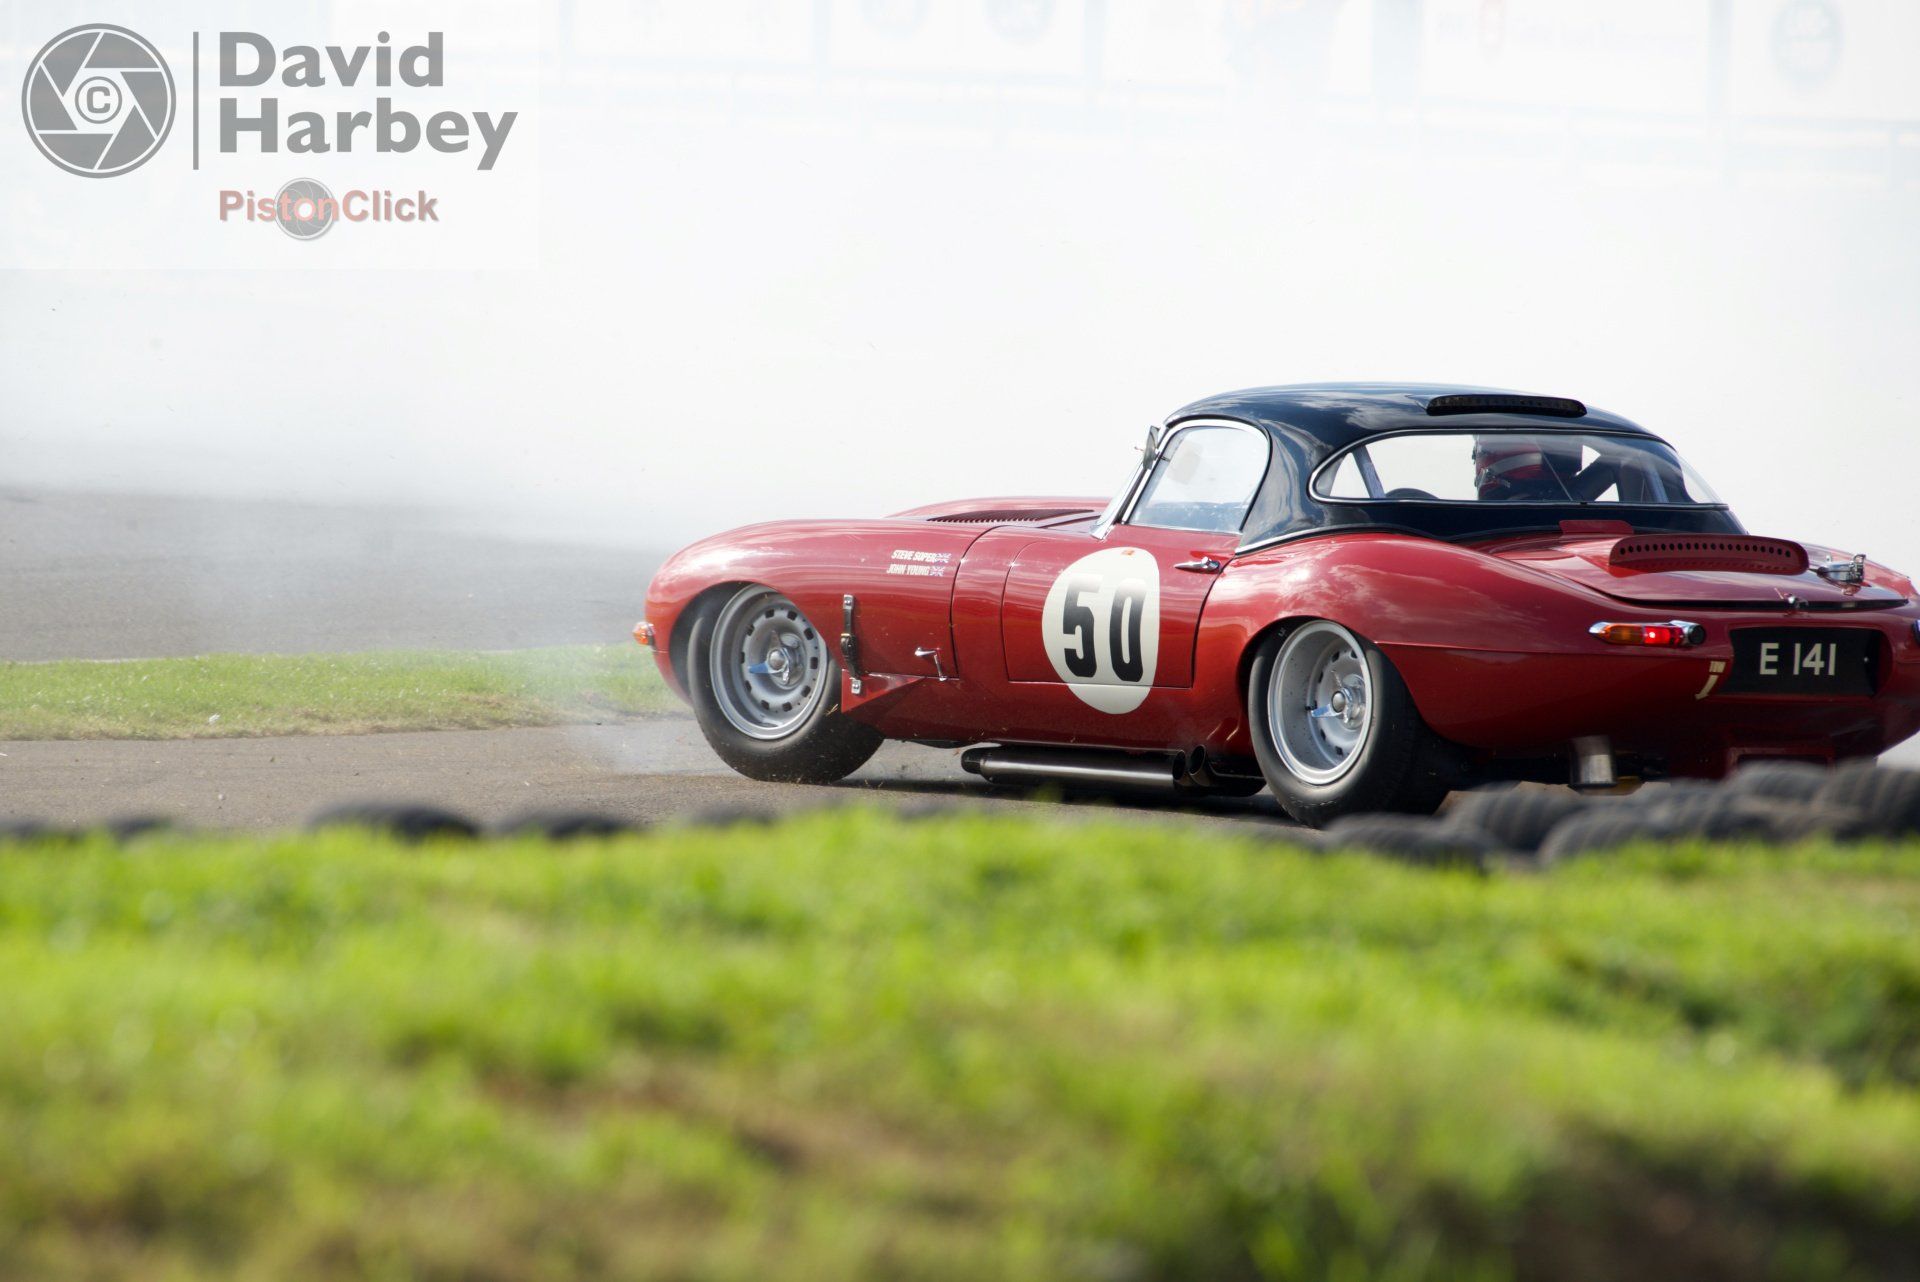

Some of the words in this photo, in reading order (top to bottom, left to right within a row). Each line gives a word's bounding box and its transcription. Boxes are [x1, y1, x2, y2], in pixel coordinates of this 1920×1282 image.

[891, 549, 915, 560] STEVE
[887, 563, 905, 574] JOHN
[906, 565, 931, 576] YOUNG
[1062, 573, 1147, 682] 50
[1759, 642, 1779, 676] E
[1793, 643, 1837, 676] 141
